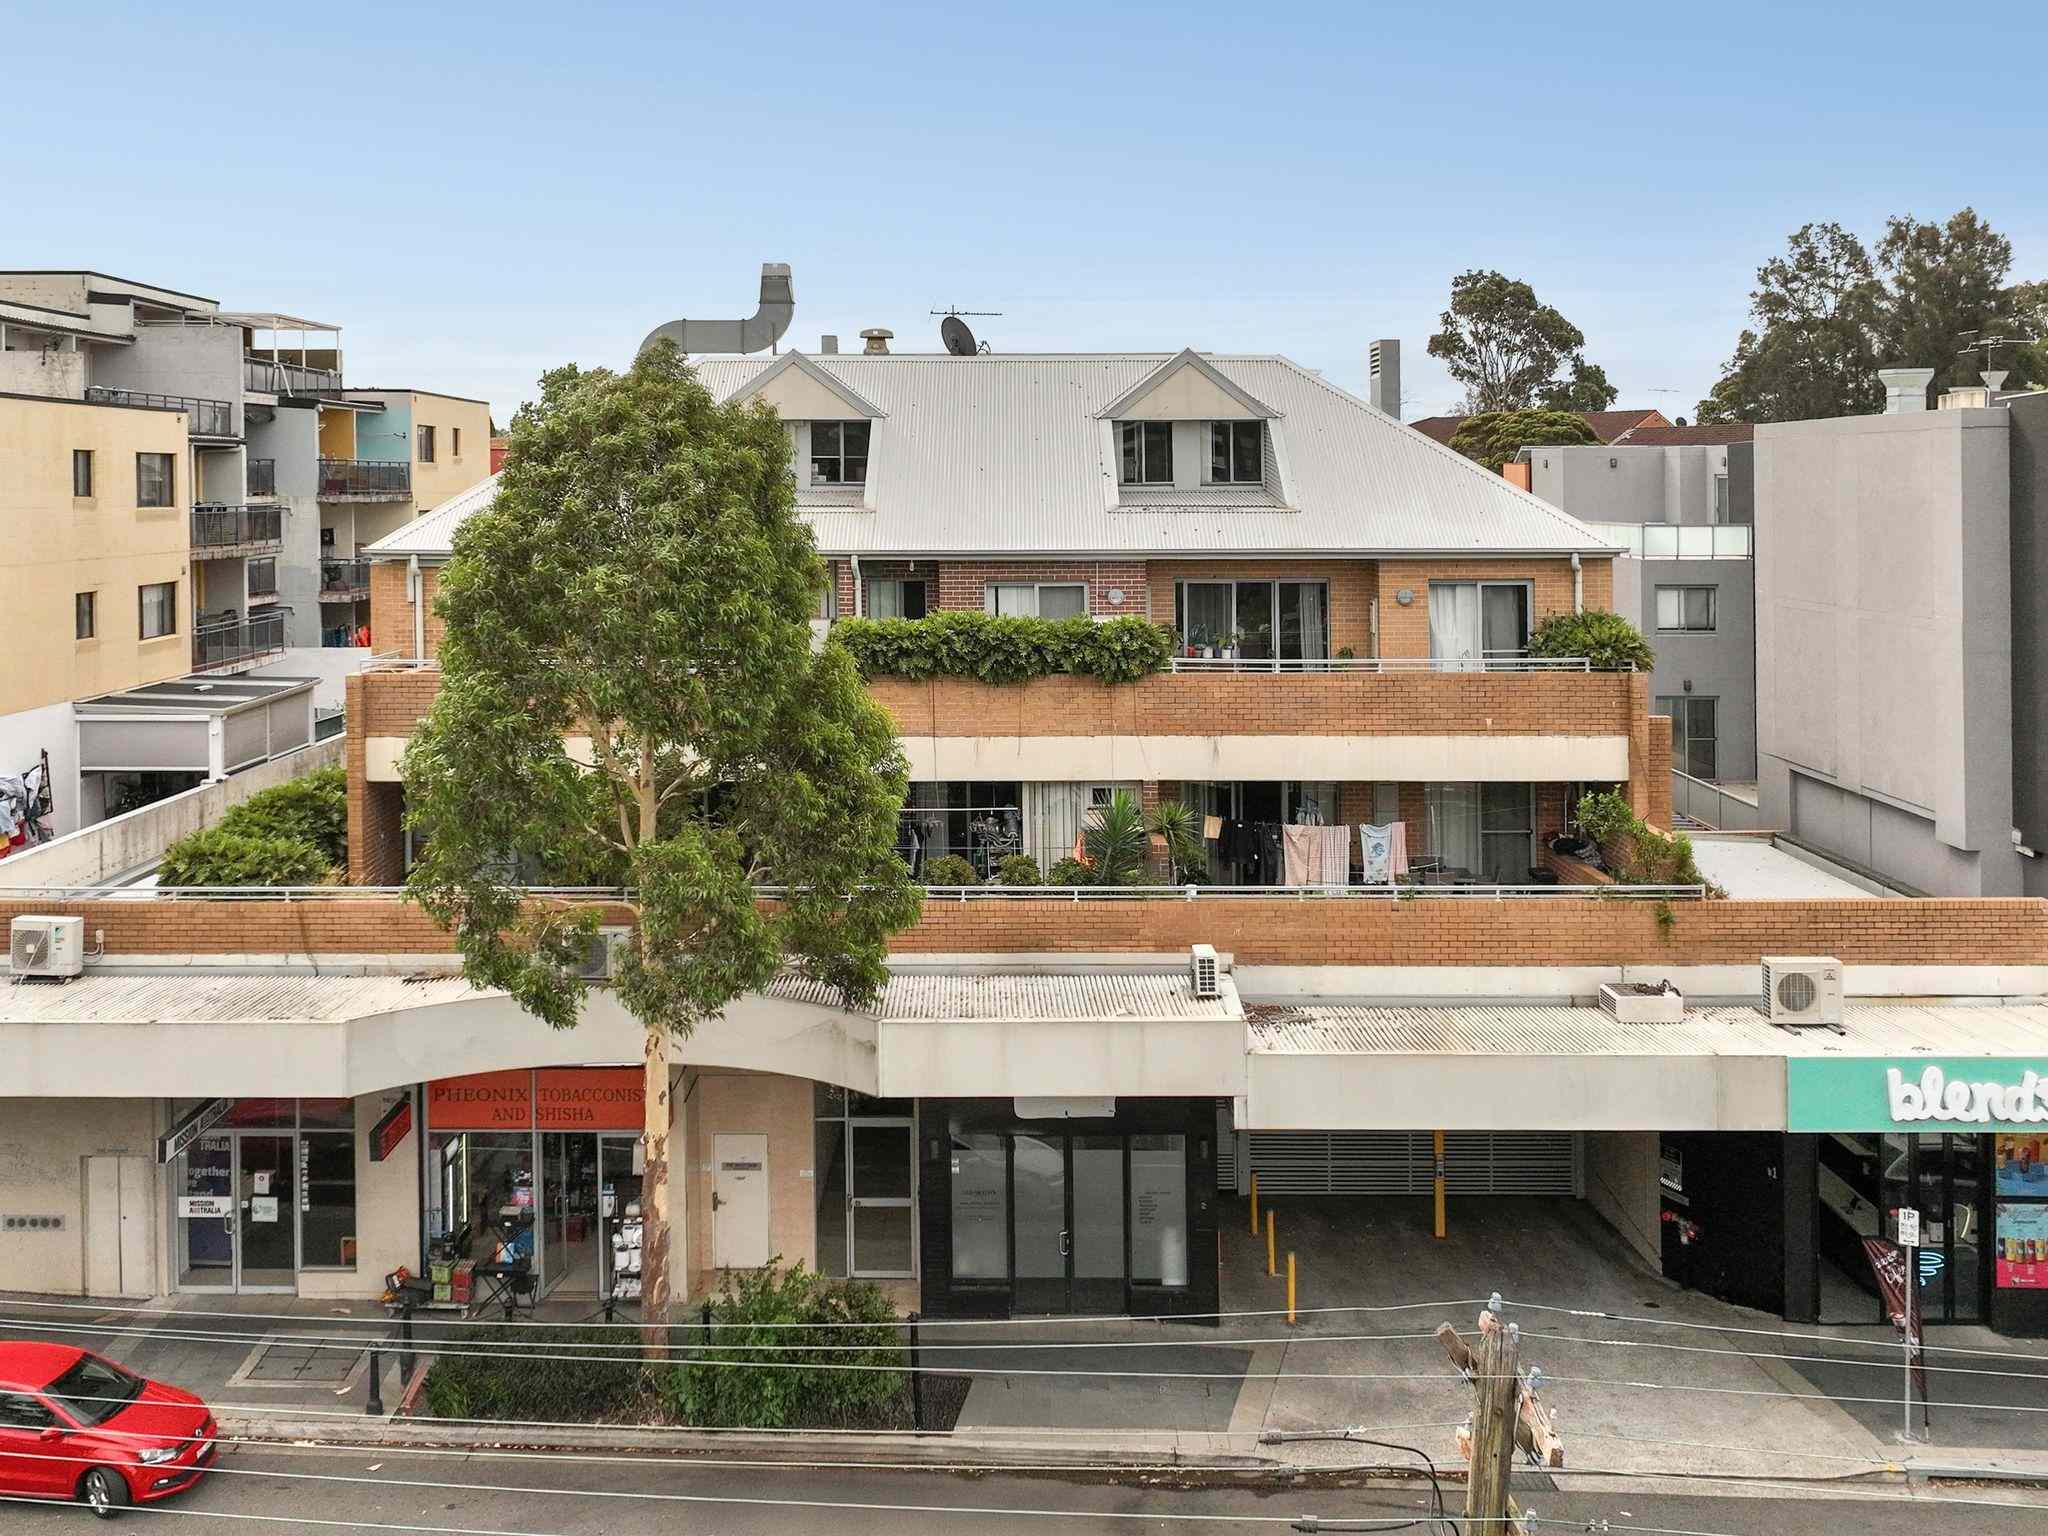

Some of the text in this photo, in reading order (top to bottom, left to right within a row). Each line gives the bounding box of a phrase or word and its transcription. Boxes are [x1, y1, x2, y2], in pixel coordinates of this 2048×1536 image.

[433, 1087, 645, 1102] PHEONIX TOBACCONIS
[491, 1106, 595, 1121] AND SHISHA
